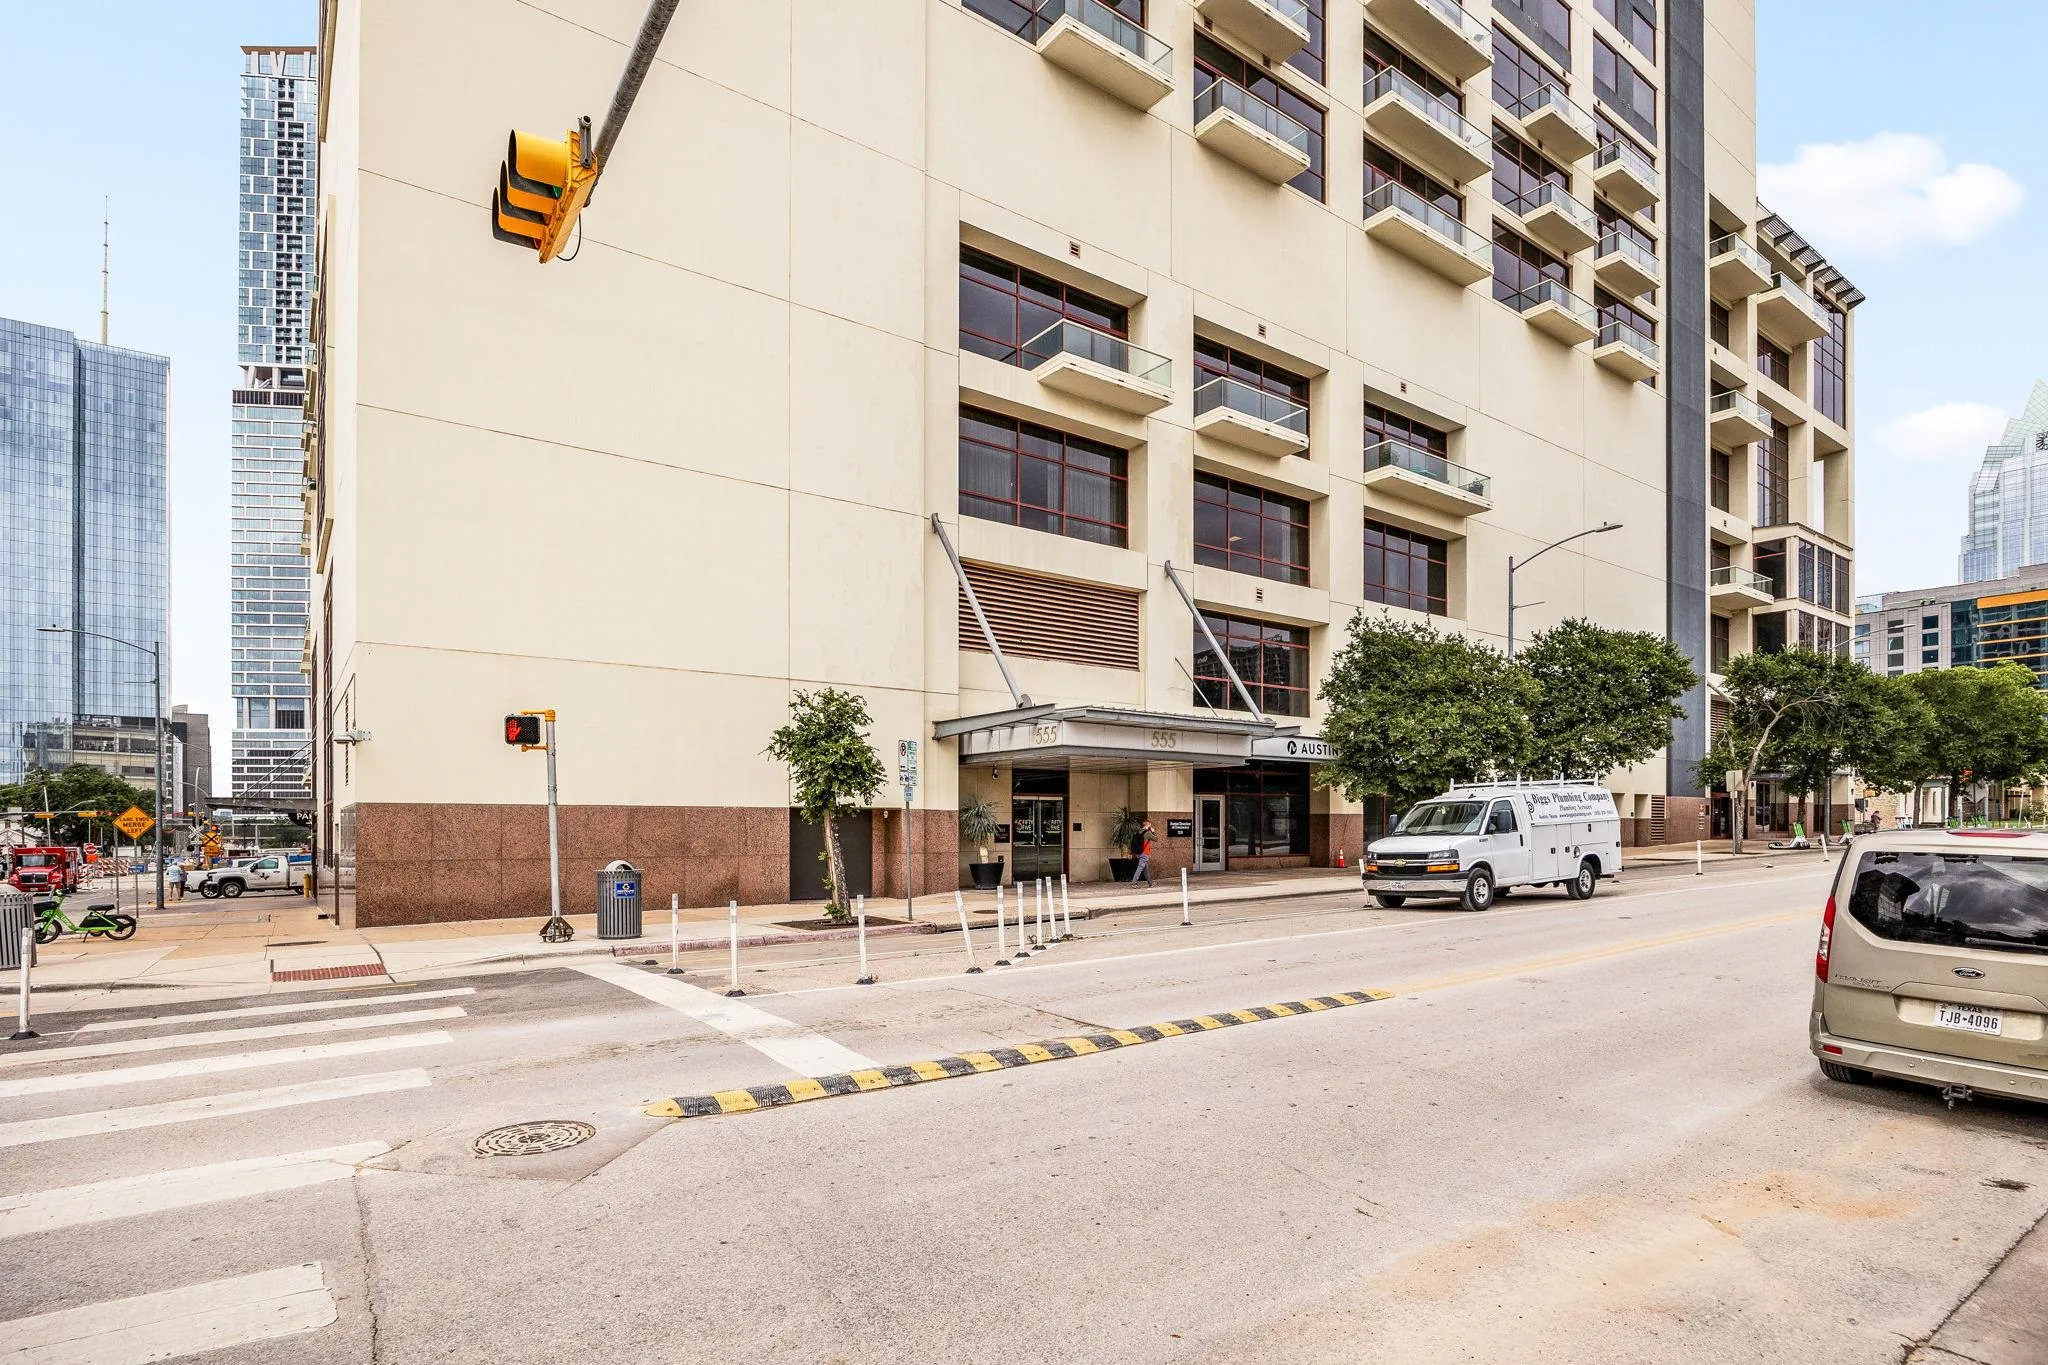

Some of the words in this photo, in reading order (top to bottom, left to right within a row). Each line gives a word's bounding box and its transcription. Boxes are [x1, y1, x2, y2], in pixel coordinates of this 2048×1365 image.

[1035, 725, 1057, 744] 555
[1151, 731, 1176, 749] 555
[1301, 743, 1339, 756] AUSTIN
[1531, 793, 1551, 805] Biggs
[1552, 792, 1582, 803] Plumbing
[1583, 791, 1610, 802] Company
[1959, 970, 1976, 978] Ford
[1957, 1005, 1983, 1014] TEXAS
